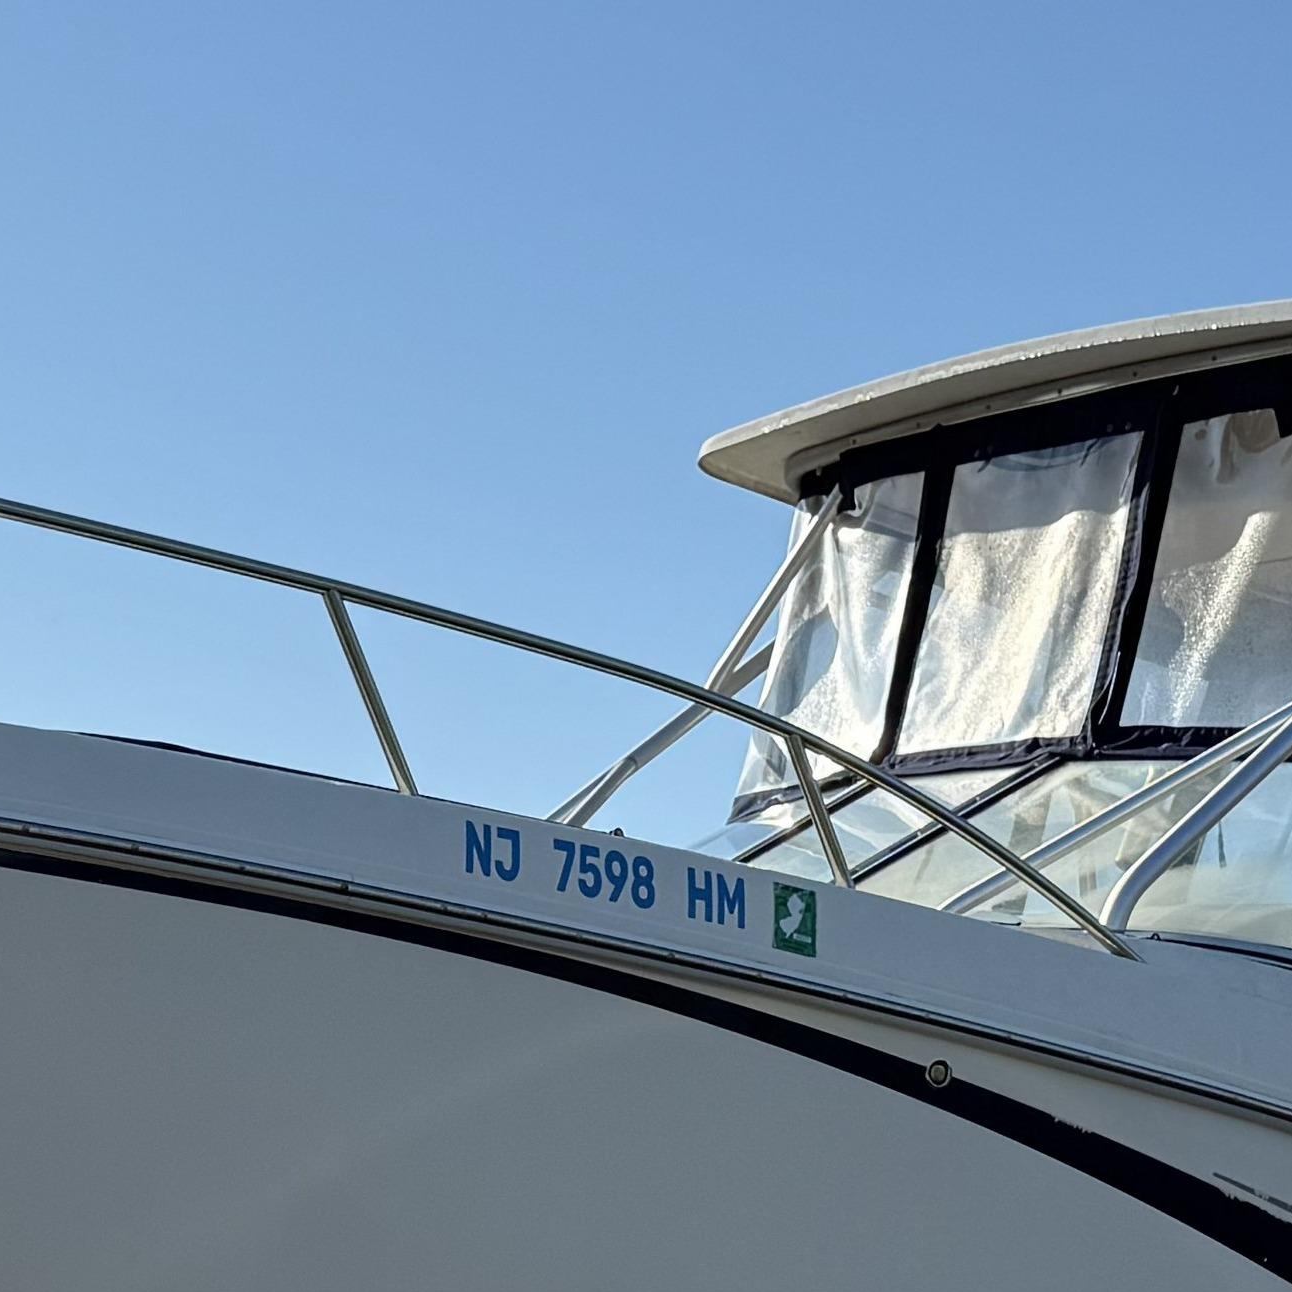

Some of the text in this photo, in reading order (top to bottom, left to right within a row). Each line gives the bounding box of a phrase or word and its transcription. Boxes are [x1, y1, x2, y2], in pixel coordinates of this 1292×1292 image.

[464, 820, 746, 929] NJ 7598 HM
